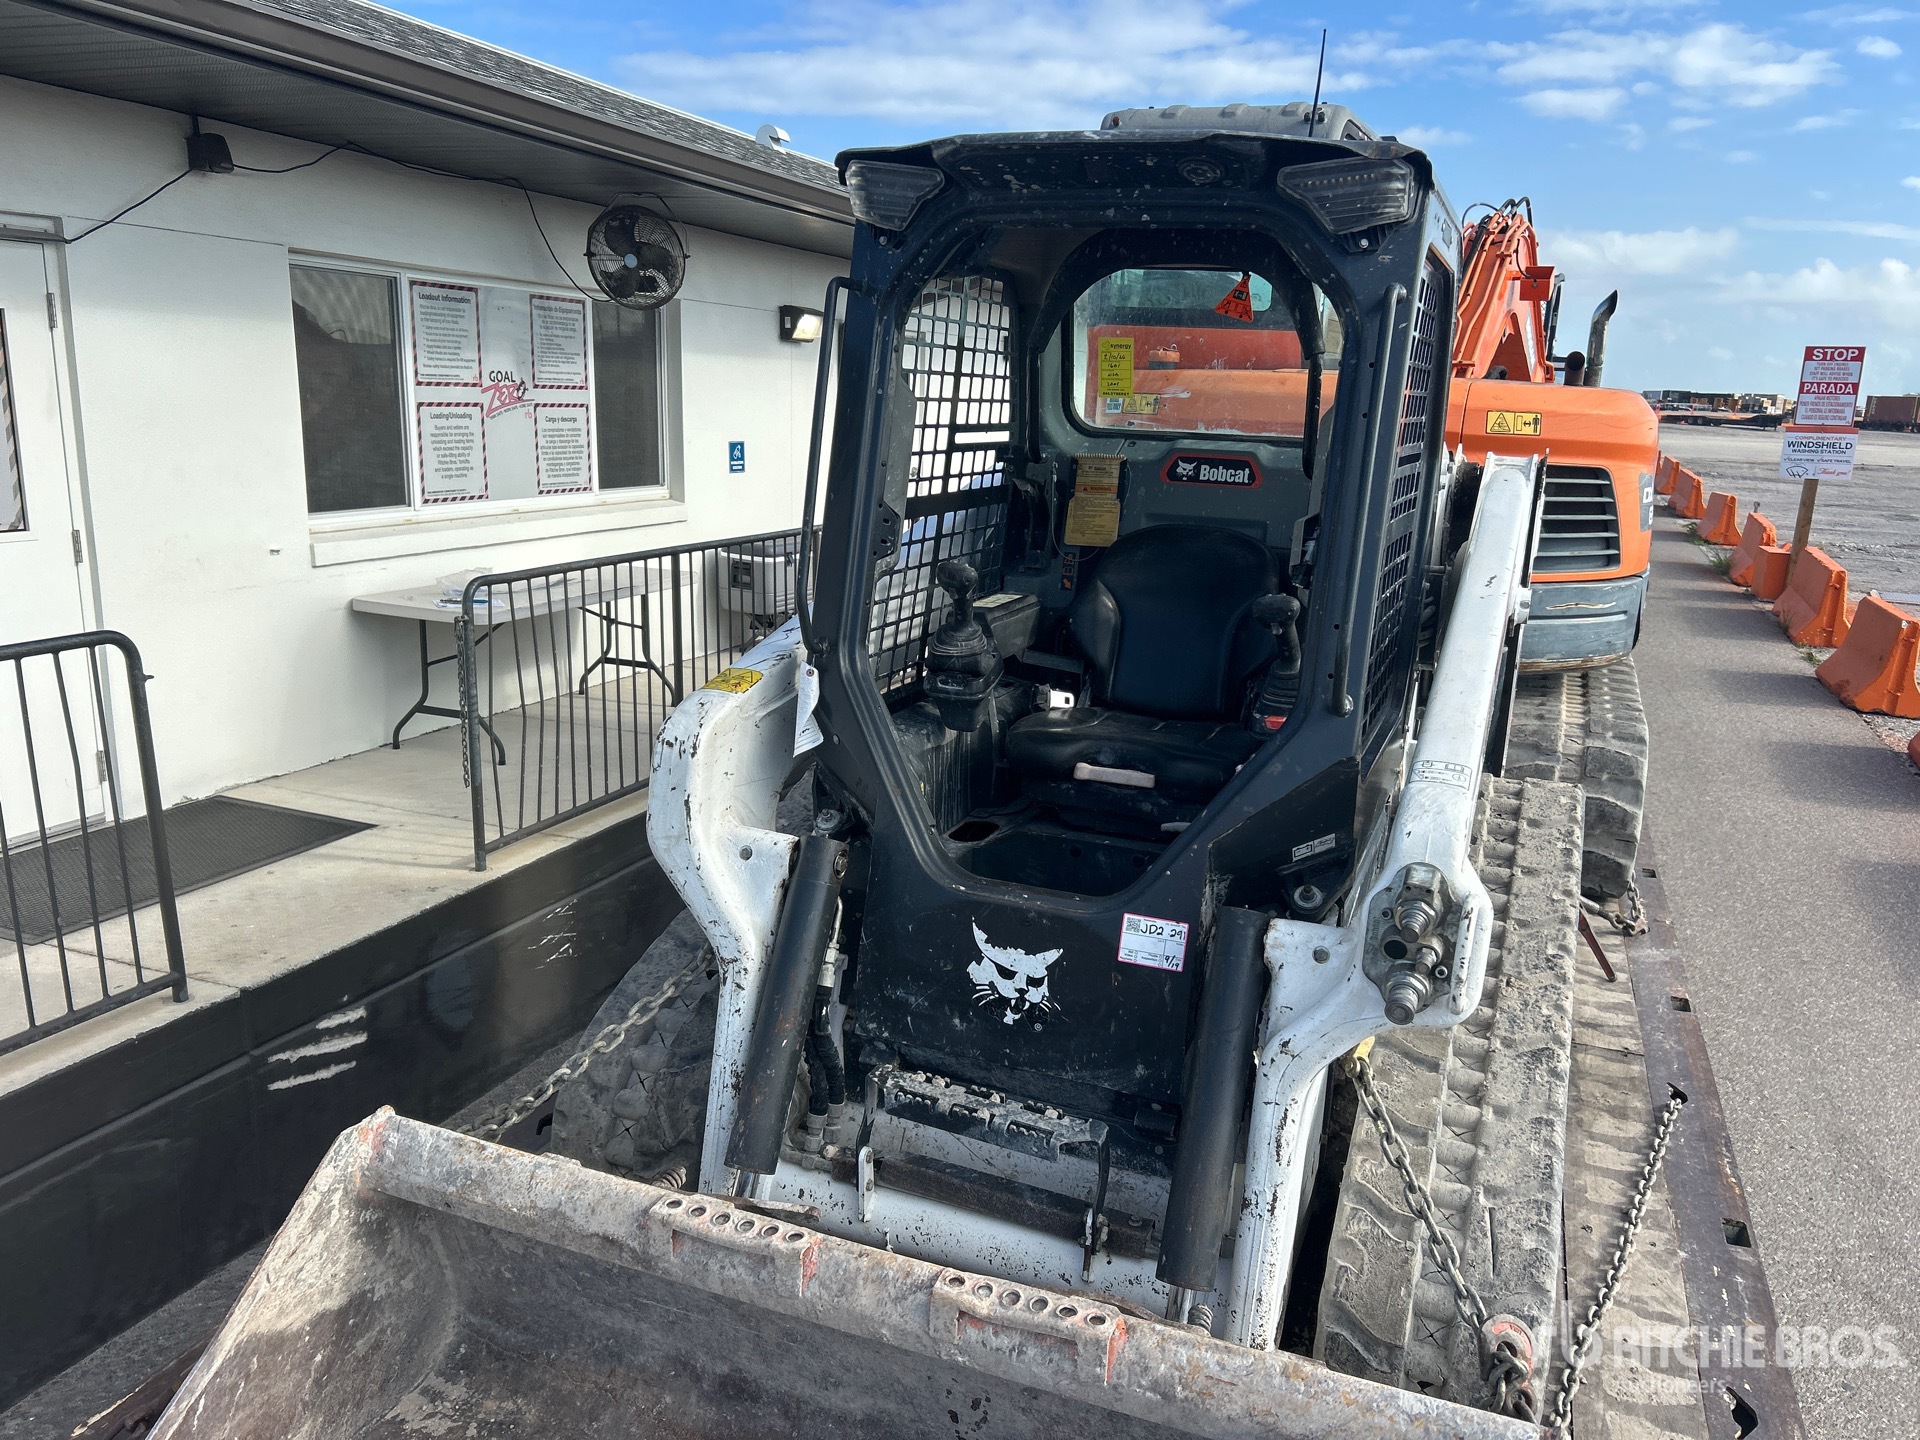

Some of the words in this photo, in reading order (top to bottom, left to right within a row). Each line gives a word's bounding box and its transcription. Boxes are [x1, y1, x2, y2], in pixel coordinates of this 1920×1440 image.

[419, 292, 440, 301] Loadout
[441, 294, 472, 304] Information
[1812, 348, 1859, 361] STOP
[489, 370, 516, 382] GOAL
[1804, 383, 1853, 394] PARADA
[430, 412, 472, 420] Loading/Unloading
[525, 409, 532, 419] rb
[545, 416, 557, 424] Carga
[560, 416, 577, 424] descarga
[1788, 441, 1853, 449] WINDSHIELD
[1200, 464, 1250, 483] Bobcat
[1140, 924, 1164, 935] JD2
[1165, 955, 1180, 970] 9/19
